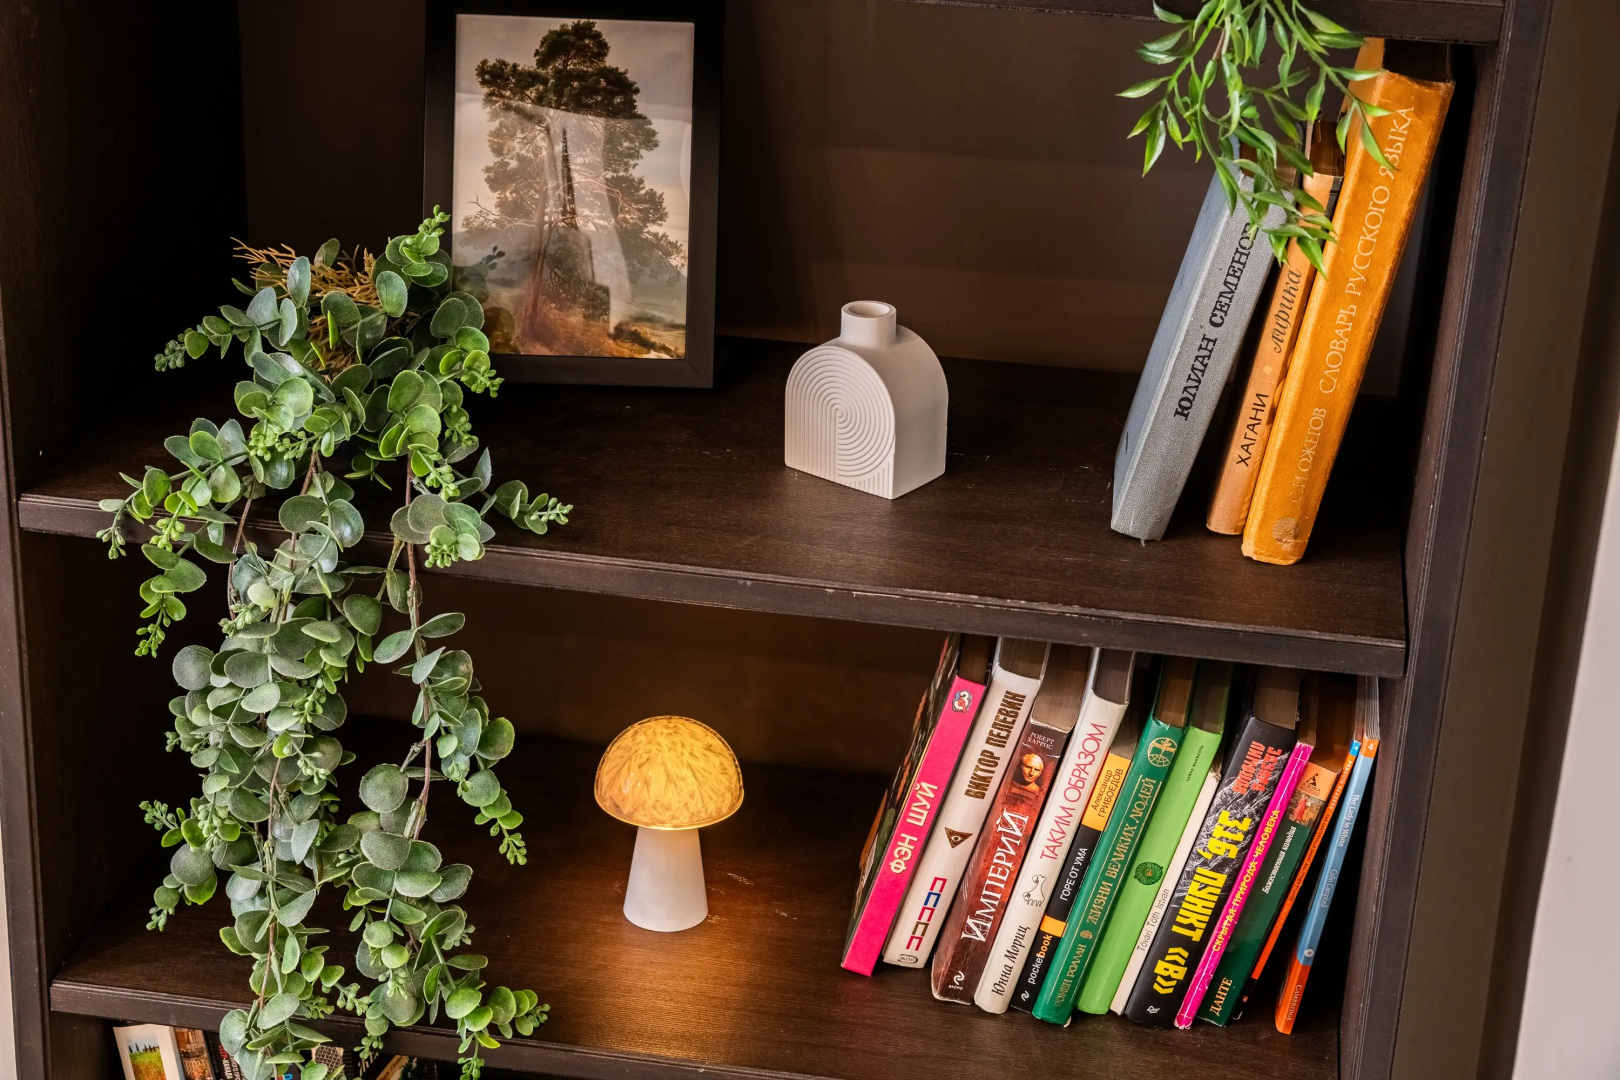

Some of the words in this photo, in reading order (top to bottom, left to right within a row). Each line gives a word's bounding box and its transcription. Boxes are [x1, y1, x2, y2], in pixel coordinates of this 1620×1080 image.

[1319, 304, 1357, 394] СЛОВАРЬ
[1345, 185, 1390, 297] РУССКОГО
[1379, 106, 1414, 180] ЯЗЫКА
[1271, 268, 1302, 354] лирика
[1174, 333, 1217, 421] ЮЛИАН
[1237, 393, 1269, 467] ХАГАНИ
[964, 749, 1001, 800] ВИКТОР
[985, 690, 1027, 749] ПЕЛЕВИН
[1232, 740, 1266, 795] ЛИМОНОВ
[1367, 742, 1374, 751] 4
[1040, 805, 1076, 860] ТАКИМ
[1064, 722, 1107, 803] ОБРАЗОМ
[1091, 769, 1113, 811] Александр
[1098, 768, 1123, 818] ГРИБОЕДОВ
[1328, 783, 1341, 810] READERS
[1338, 760, 1353, 785] PENGUIN
[1342, 820, 1351, 830] in
[1343, 804, 1357, 822] Lady
[1350, 794, 1360, 807] The
[889, 833, 918, 874] ФЭН
[906, 781, 938, 827] ШУЙ
[1087, 882, 1113, 925] ЖИЗНИ
[1105, 823, 1138, 879] ВЕЛИКИХ
[1129, 776, 1157, 824] ЛЮДЕЙ
[1197, 809, 1252, 860] 316,
[1282, 825, 1297, 851] комедия
[1337, 827, 1350, 848] White
[960, 807, 1030, 943] ИМПЕРИЙ
[1060, 877, 1076, 902] ГОРЕ
[1069, 865, 1081, 879] ОТ
[1077, 847, 1088, 867] УМА
[1212, 907, 1237, 952] СКРЫТАЯ
[1232, 861, 1258, 907] ПРИРОДА
[1253, 809, 1281, 859] ЧЕЛОВЕКА
[1326, 868, 1338, 884] Colin
[1146, 909, 1160, 928] Tóth
[1157, 888, 1170, 910] István
[1171, 866, 1228, 943] ПУНКТ
[991, 963, 1014, 997] Юнна
[1004, 925, 1031, 965] Мориц
[1028, 934, 1053, 985] pocketbook
[1054, 978, 1073, 1007] РОМЕН
[1066, 943, 1087, 978] РОЛЛАН
[1209, 977, 1233, 1017] ДАНТЕ
[1287, 985, 1303, 1022] CAMBRIDGE
